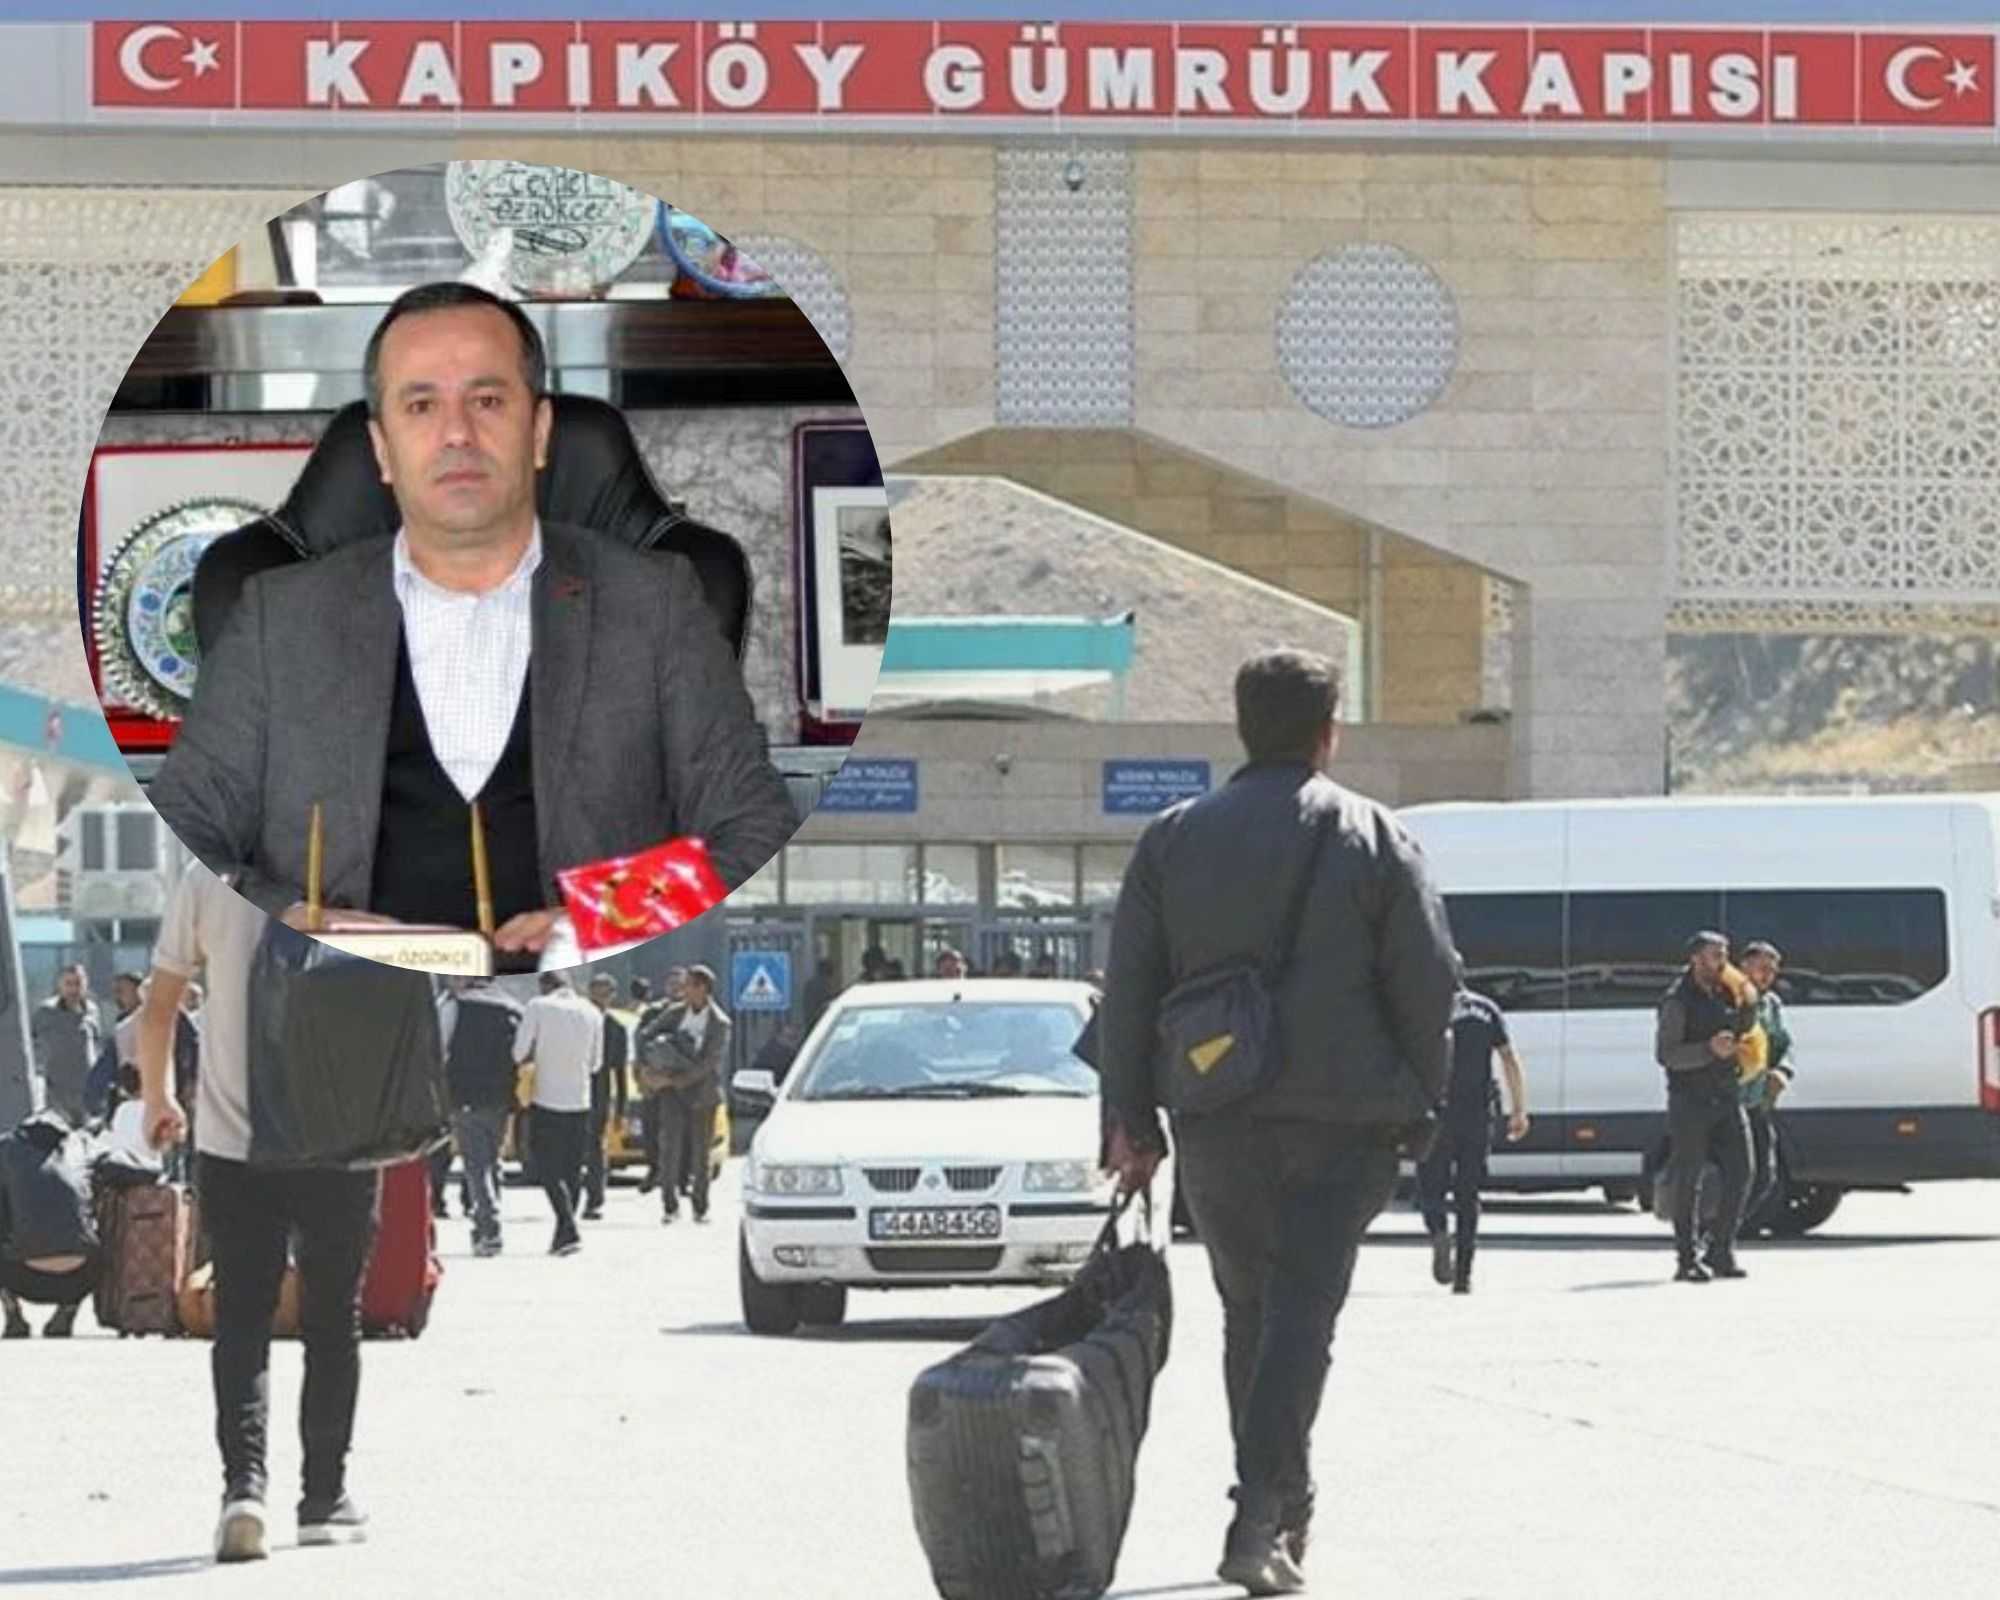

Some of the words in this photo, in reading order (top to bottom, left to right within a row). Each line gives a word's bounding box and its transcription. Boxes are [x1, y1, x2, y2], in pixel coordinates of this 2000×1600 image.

[305, 22, 865, 110] KAPIKÖY
[923, 25, 1392, 114] GÜMRÜK
[1436, 51, 1797, 119] KAPISI
